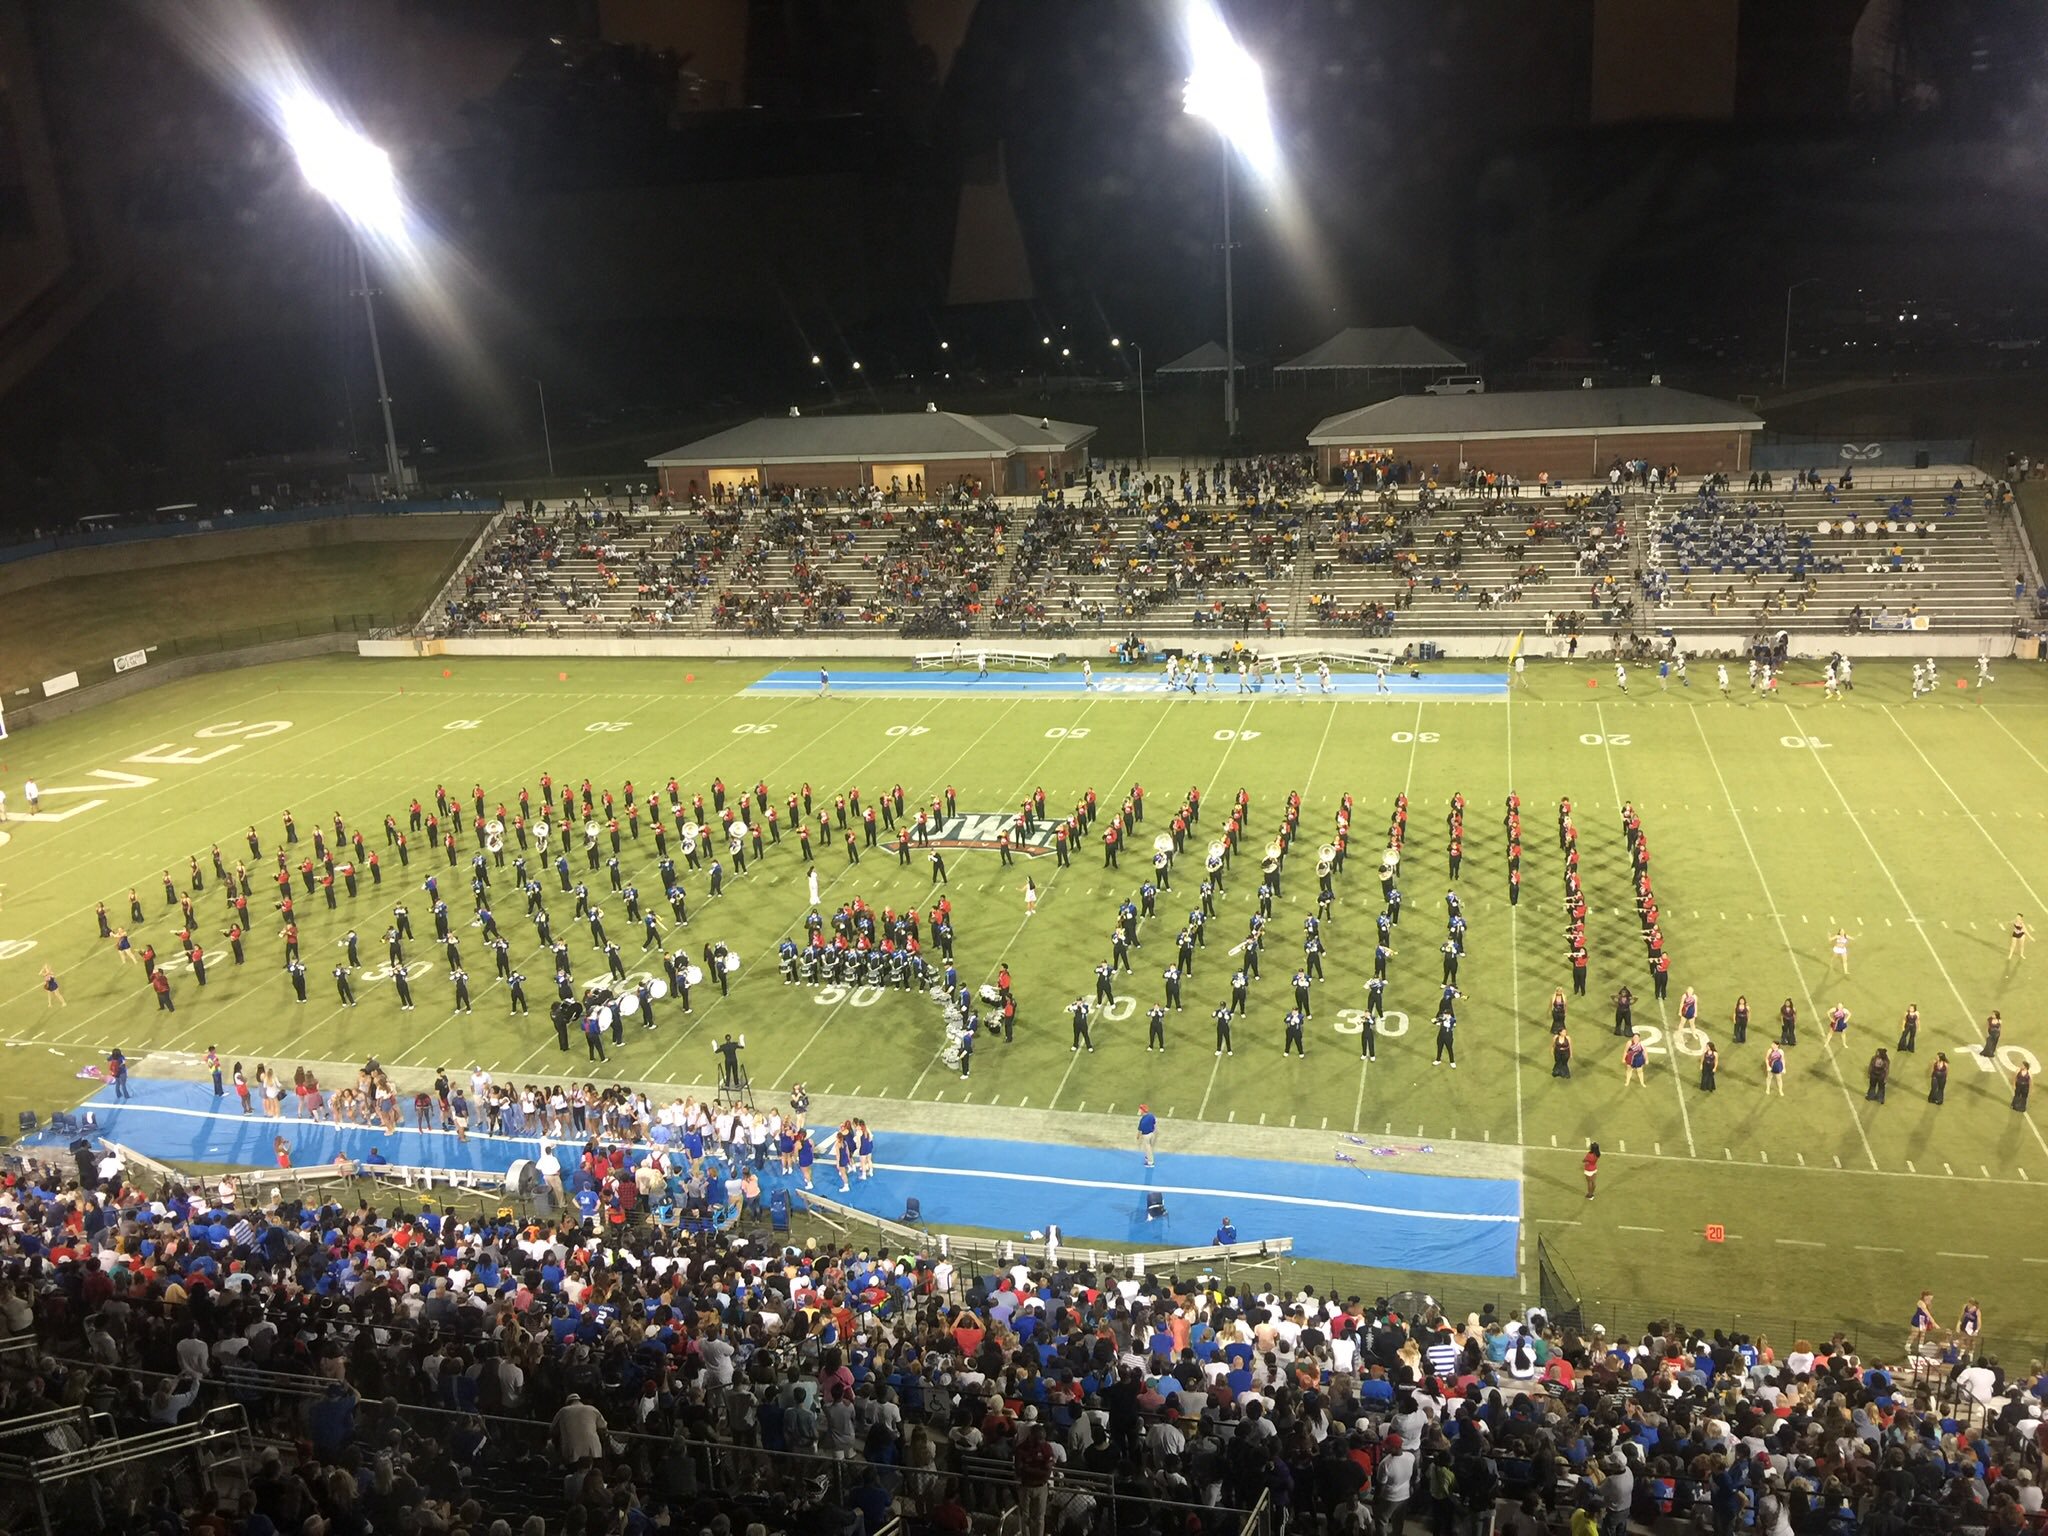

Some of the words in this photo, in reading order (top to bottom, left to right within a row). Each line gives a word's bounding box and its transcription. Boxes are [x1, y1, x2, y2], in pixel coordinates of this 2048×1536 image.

[584, 721, 633, 732] 20
[732, 723, 778, 734] 30
[885, 725, 931, 736] 40
[1044, 727, 1091, 739] 50
[1213, 729, 1261, 741] 40
[1391, 731, 1440, 743] 30
[1579, 733, 1631, 746] 20
[1779, 736, 1832, 749] 10
[361, 960, 434, 981] 30
[581, 972, 653, 994] 40
[814, 981, 887, 1007] 50
[1333, 1008, 1410, 1037] 30
[1632, 1025, 1711, 1056] 20
[1954, 1043, 2042, 1075] 10
[1709, 1226, 1722, 1240] 20
[595, 1310, 608, 1325] 2
